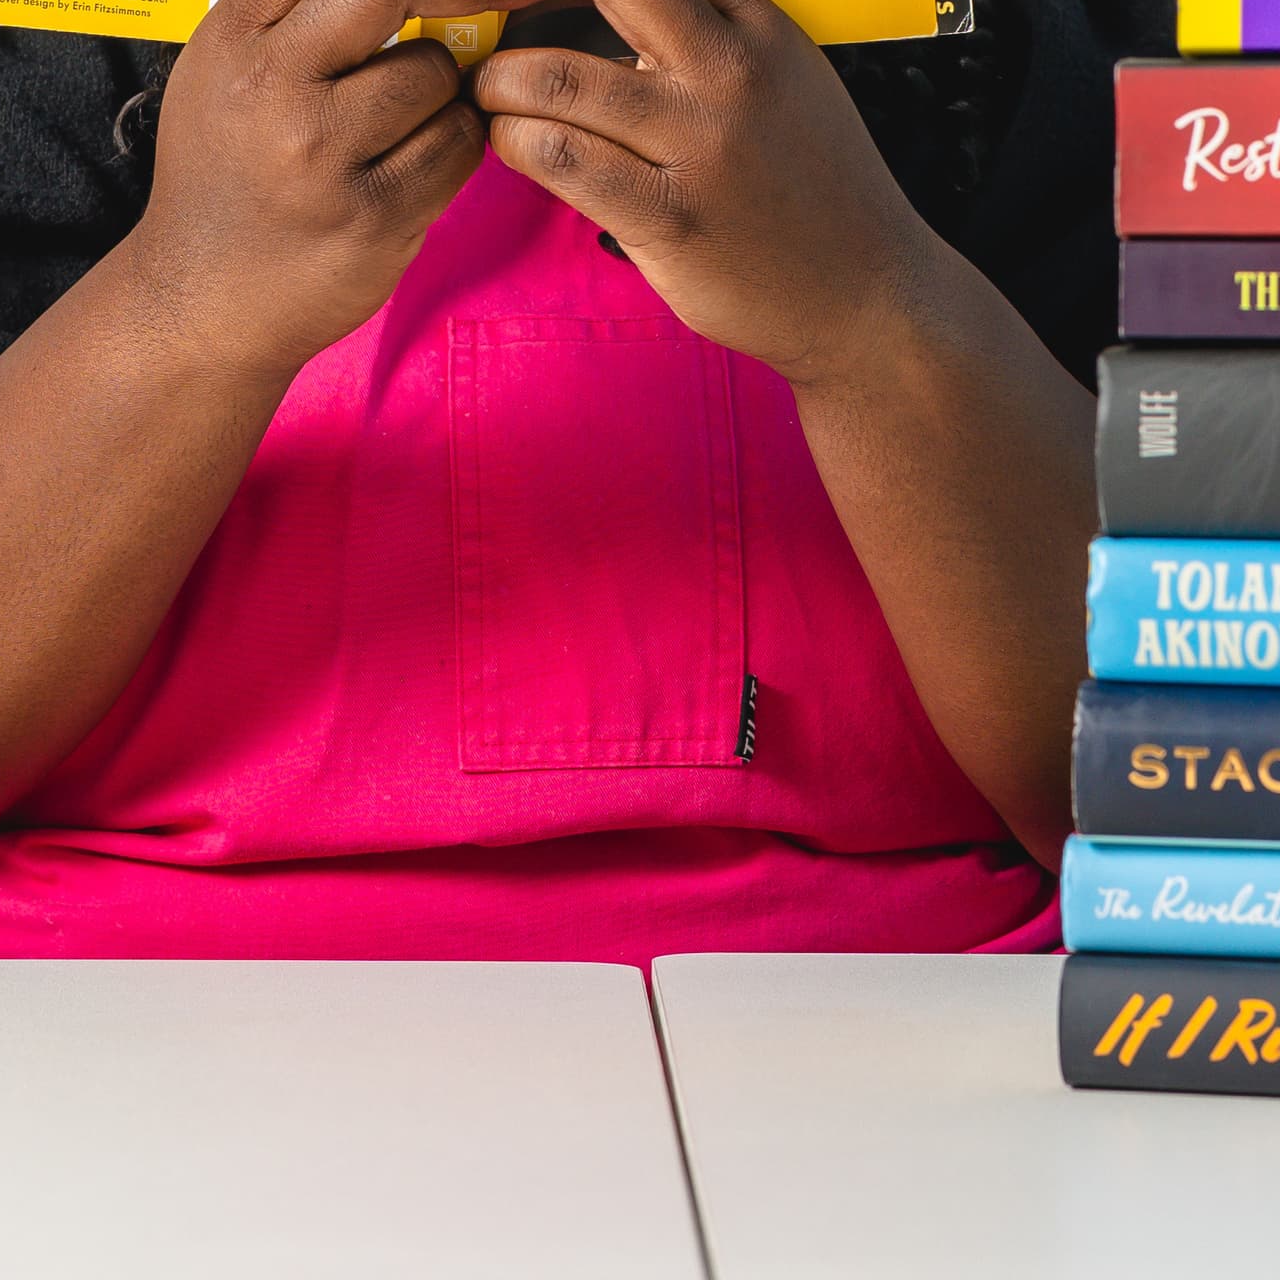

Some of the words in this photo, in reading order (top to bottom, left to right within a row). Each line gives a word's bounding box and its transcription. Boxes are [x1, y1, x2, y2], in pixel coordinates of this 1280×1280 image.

[58, 0, 70, 12] by
[72, 1, 92, 13] Erin
[94, 3, 152, 18] Fitzsimmons
[1138, 388, 1179, 458] WOLFE
[1094, 885, 1143, 919] The
[1093, 992, 1174, 1067] If
[1166, 995, 1218, 1059] I
